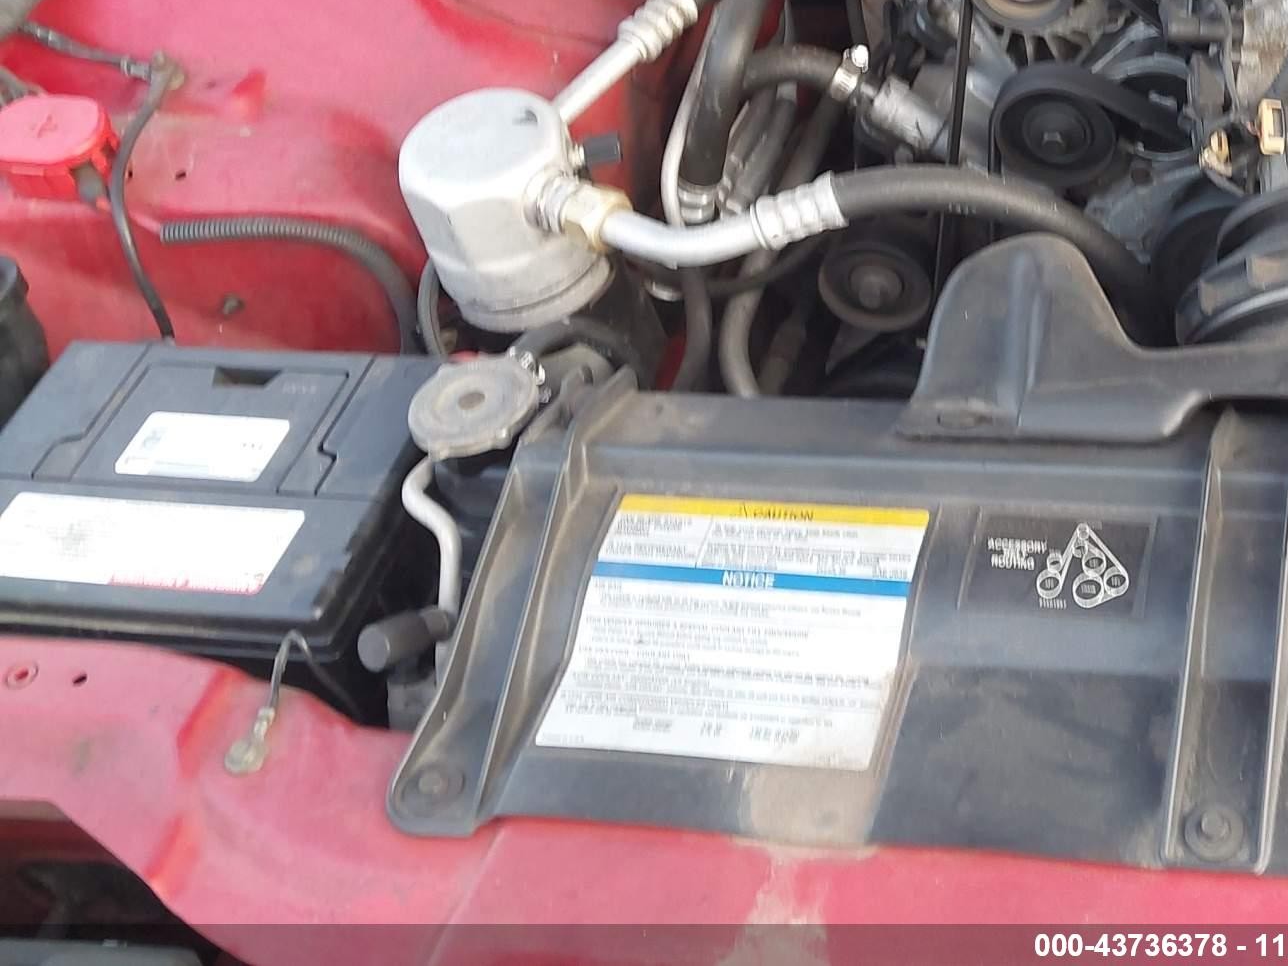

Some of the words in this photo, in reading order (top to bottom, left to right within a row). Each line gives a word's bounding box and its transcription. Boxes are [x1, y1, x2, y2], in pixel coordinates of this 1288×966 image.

[753, 506, 814, 522] CAUTION
[987, 536, 1048, 555] ACCESSORY
[991, 553, 1035, 571] ROUTING
[722, 569, 775, 589] NOTICE
